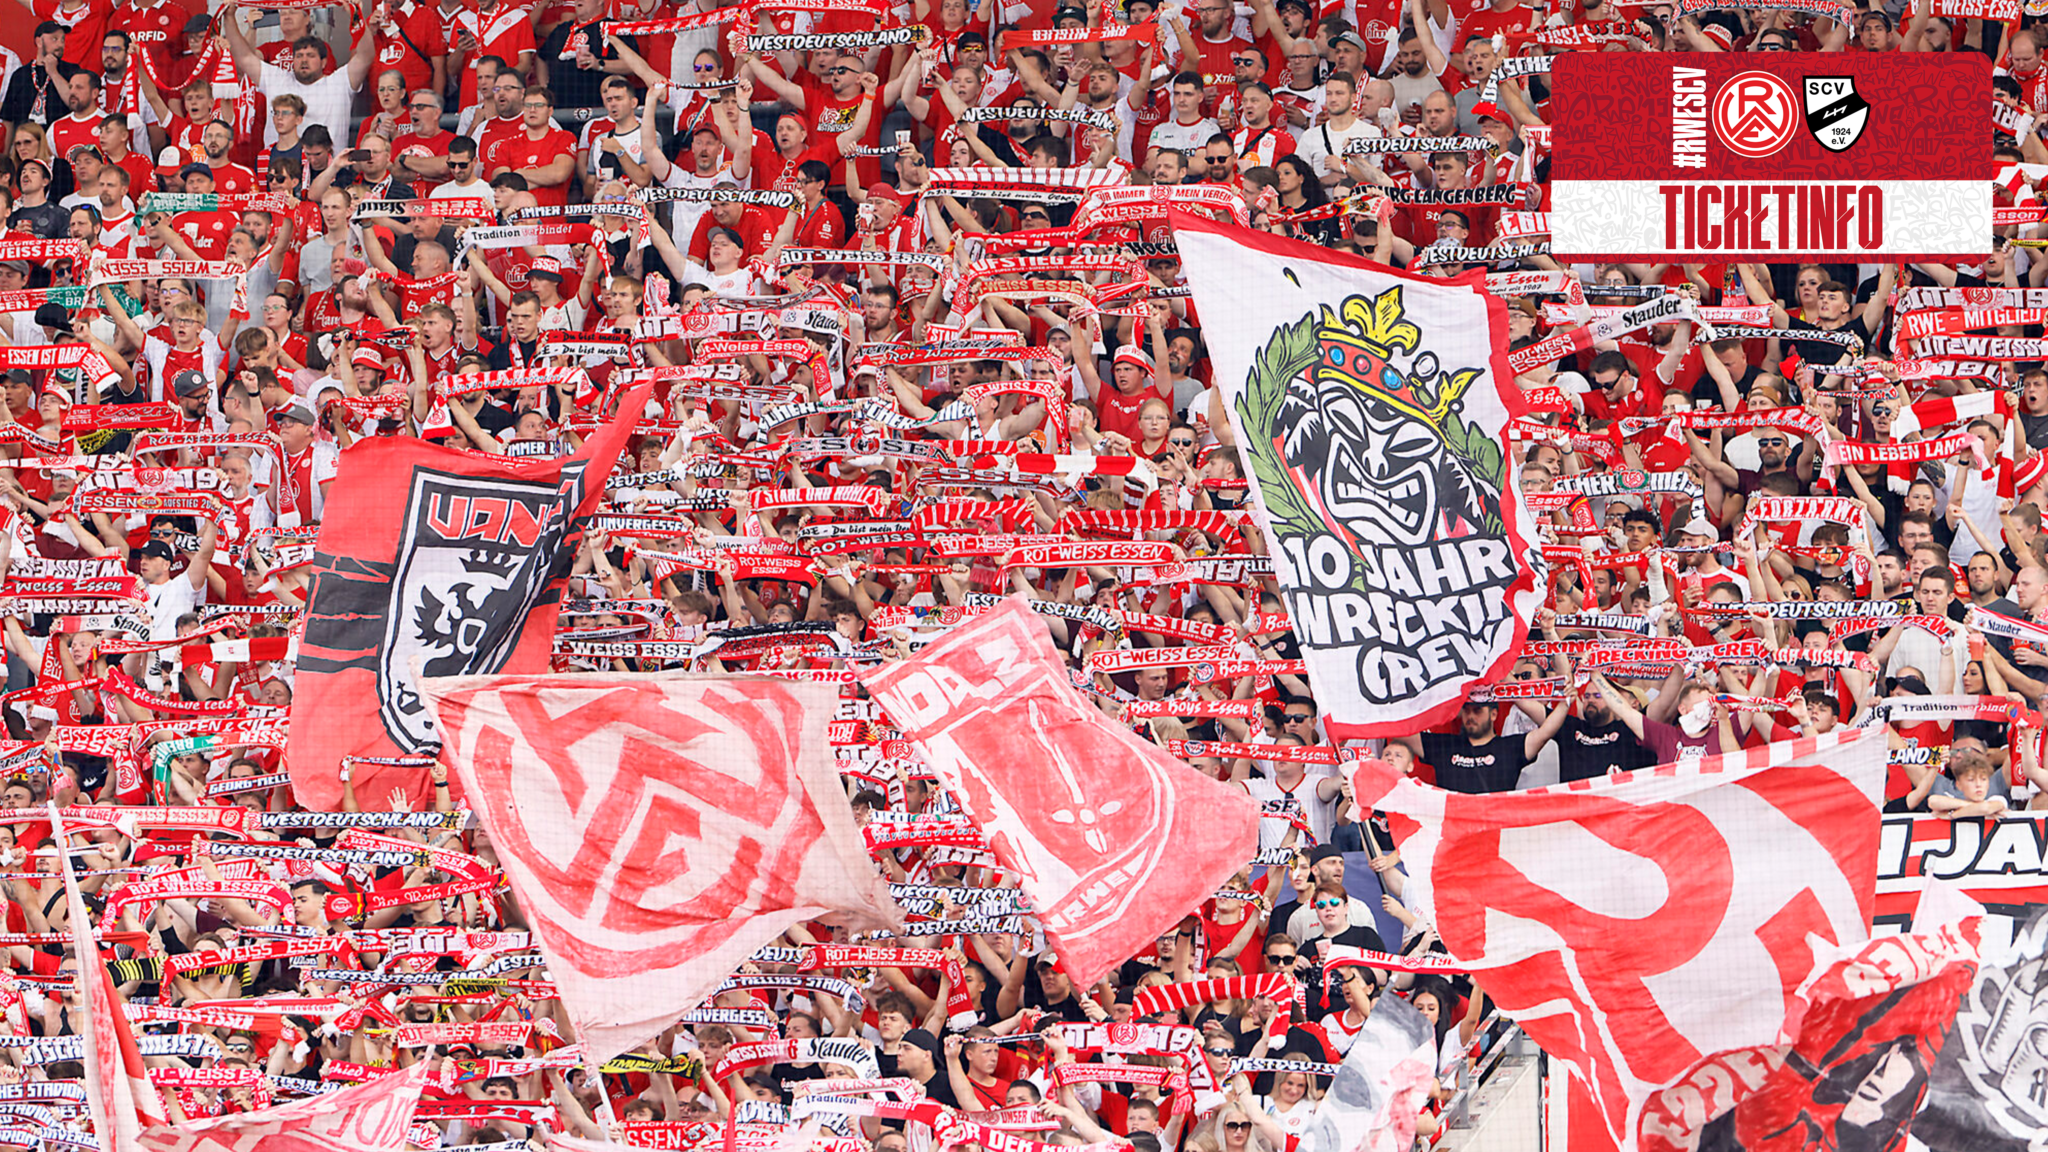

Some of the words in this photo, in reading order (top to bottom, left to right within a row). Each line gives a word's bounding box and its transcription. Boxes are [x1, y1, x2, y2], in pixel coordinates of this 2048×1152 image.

[128, 30, 167, 42] ARFID
[749, 27, 912, 50] WESTDEUTSCHLAND
[635, 186, 793, 209] WESTDEUTSCHLAND
[1112, 190, 1145, 200] IMMER
[1175, 189, 1200, 198] MEIN
[1202, 189, 1233, 202] VEREIN
[153, 199, 203, 208] BREMEN
[247, 200, 285, 209] ESSEN
[358, 201, 405, 217] Staud
[471, 228, 521, 241] Tradition
[1065, 254, 1126, 267] 2004
[100, 262, 148, 277] ESSEN
[1505, 273, 1550, 285] Essen
[1622, 297, 1682, 329] Stauder
[1907, 311, 1946, 335] RWE
[1964, 309, 2042, 329] MITGLIED
[562, 345, 577, 355] Du
[579, 345, 596, 354] bist
[598, 347, 618, 355] mein
[762, 340, 809, 354] Essen
[1507, 334, 1573, 364] ROT-WEISS
[8, 348, 40, 364] ESSEN
[41, 347, 60, 364] IST
[886, 350, 968, 361] Rot-Weiss
[1512, 344, 1576, 374] ESSEN
[1839, 444, 1863, 460] EIN
[1869, 442, 1921, 461] LEBEN
[82, 496, 138, 508] ESSEN
[163, 498, 199, 508] AUFSTIEG
[832, 524, 848, 534] Du
[810, 534, 914, 556] ROT-WEISS
[941, 538, 1014, 550] ROT-WEISS
[1023, 543, 1106, 563] ROT-WEISS
[1110, 542, 1164, 559] ESSEN
[739, 557, 801, 569] ROT-WEISS
[1281, 534, 1351, 589] 10
[751, 567, 788, 575] ESSEN
[72, 580, 122, 593] Essen
[1986, 619, 2022, 635] Stauder
[1092, 649, 1184, 667] ROT-WEISS
[1186, 647, 1241, 660] ESSEN
[1494, 682, 1554, 697] CREW
[1206, 701, 1249, 715] Essen
[1902, 702, 1958, 712] Tradition
[1289, 747, 1330, 761] Essen
[262, 812, 443, 828] WESTDEUTSCHLAND
[212, 842, 414, 866] WESTDEUTSCHLAND
[131, 880, 216, 895] ROT-WEISS
[220, 881, 269, 894] ESSEN
[170, 944, 272, 971] ROT-WEISS
[286, 938, 347, 954] ESSEN
[825, 951, 897, 962] ROT-WEISS
[901, 950, 945, 963] ESSEN
[1359, 947, 1394, 962] 1907
[807, 1038, 871, 1065] Stauder
[156, 1078, 177, 1086] WIR
[181, 1078, 215, 1086] SIND
[806, 1092, 858, 1105] Tradition
